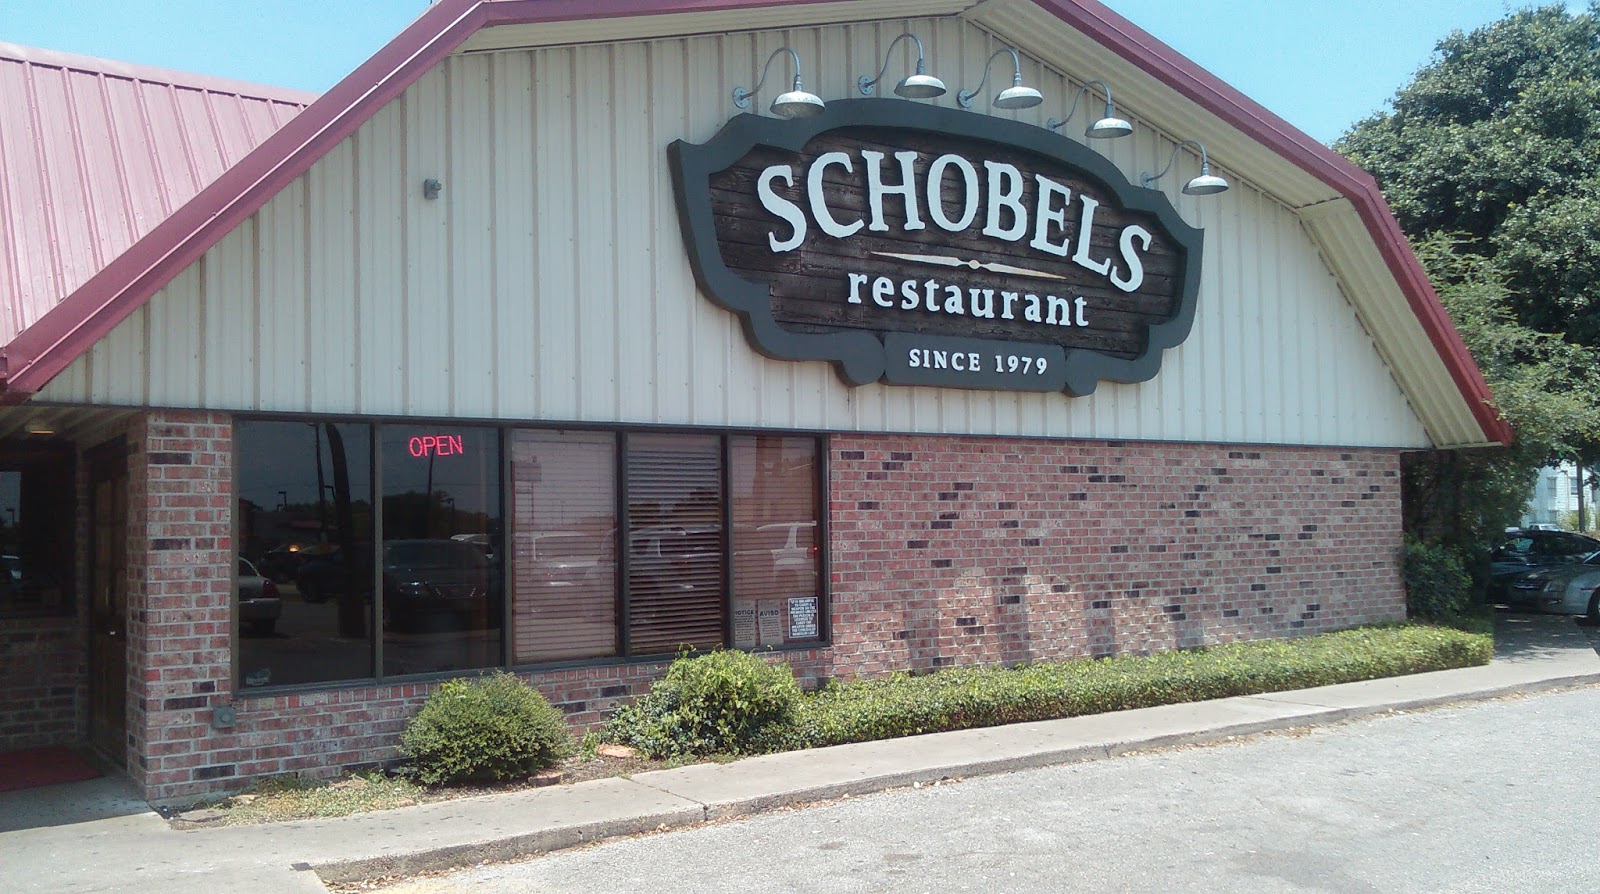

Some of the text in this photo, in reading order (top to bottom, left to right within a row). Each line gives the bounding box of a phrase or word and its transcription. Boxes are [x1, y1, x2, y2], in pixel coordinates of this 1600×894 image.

[756, 149, 1152, 292] SCHOBELS
[847, 272, 1090, 327] restaurant
[908, 348, 1048, 375] SINCE 1979
[409, 435, 463, 457] OPEN
